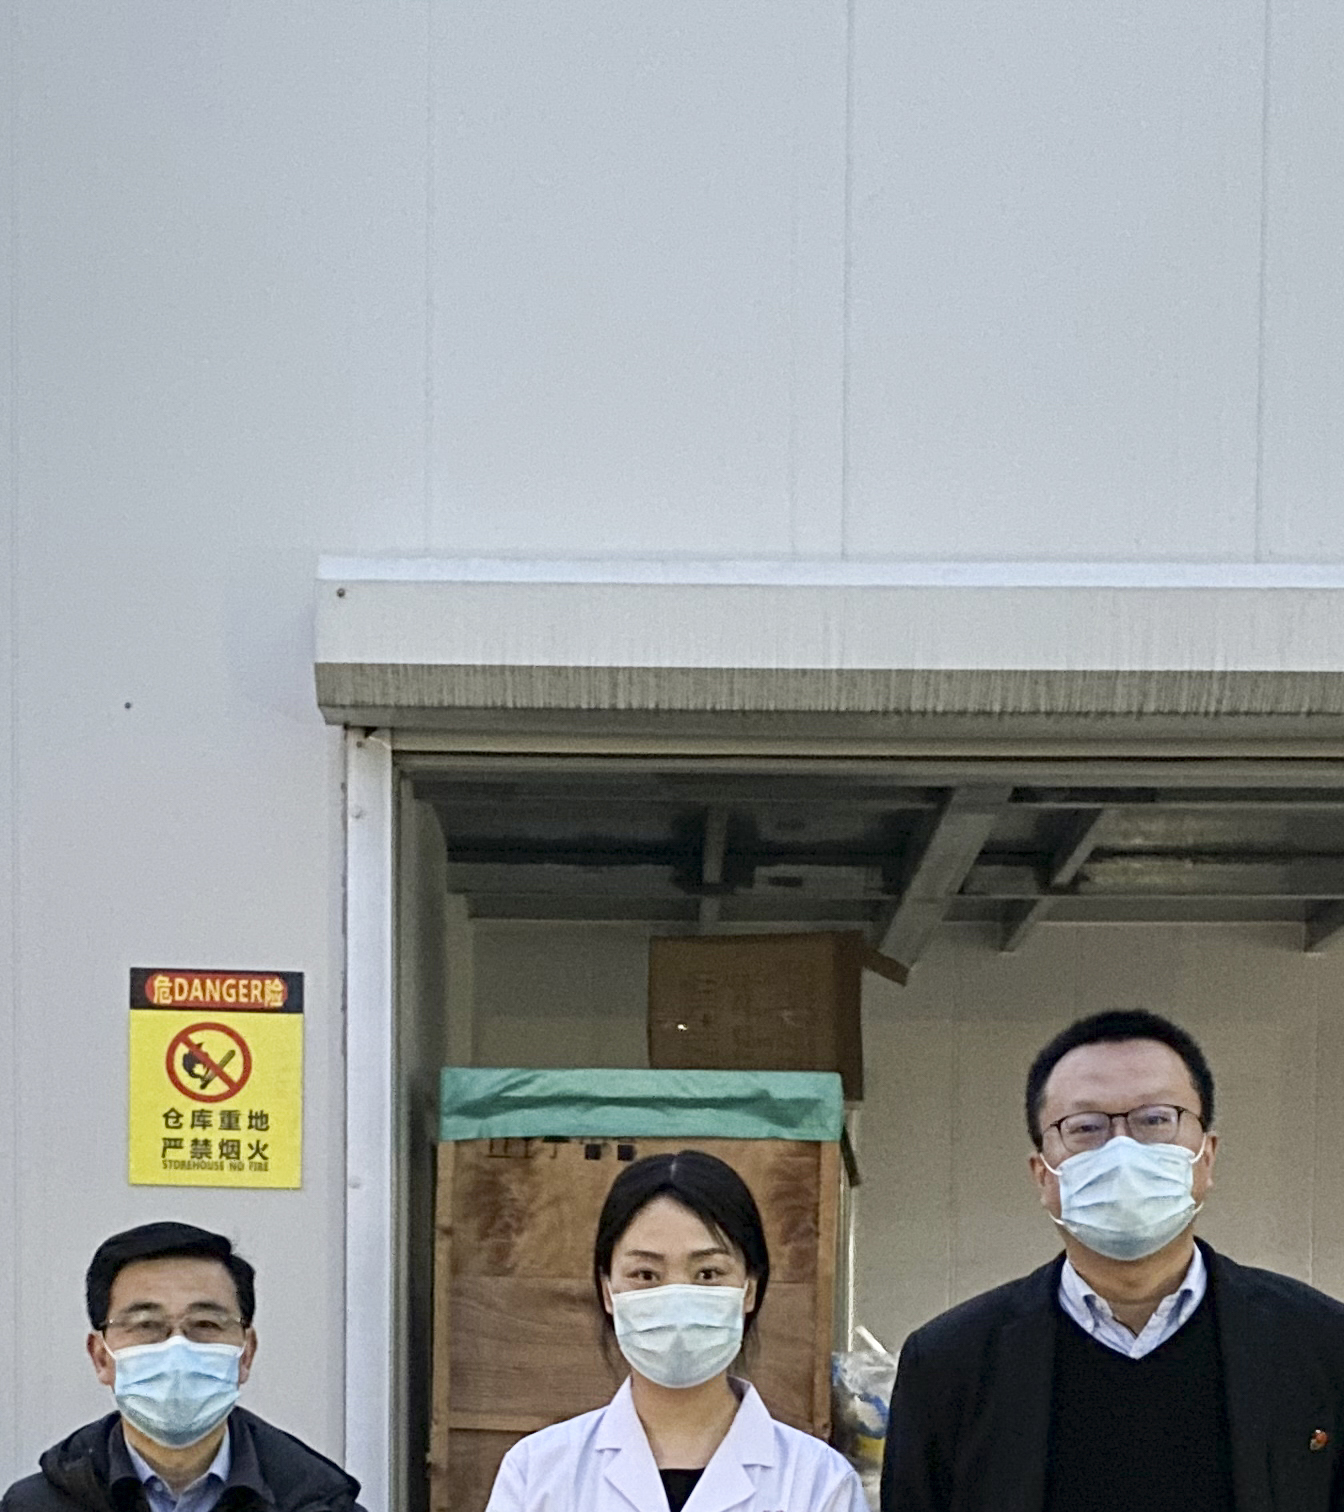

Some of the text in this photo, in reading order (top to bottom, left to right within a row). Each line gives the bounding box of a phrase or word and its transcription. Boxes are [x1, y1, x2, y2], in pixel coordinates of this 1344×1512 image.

[162, 1107, 270, 1132] 仓库重地
[161, 1138, 269, 1160] 严禁烟火
[229, 1162, 245, 1171] NO
